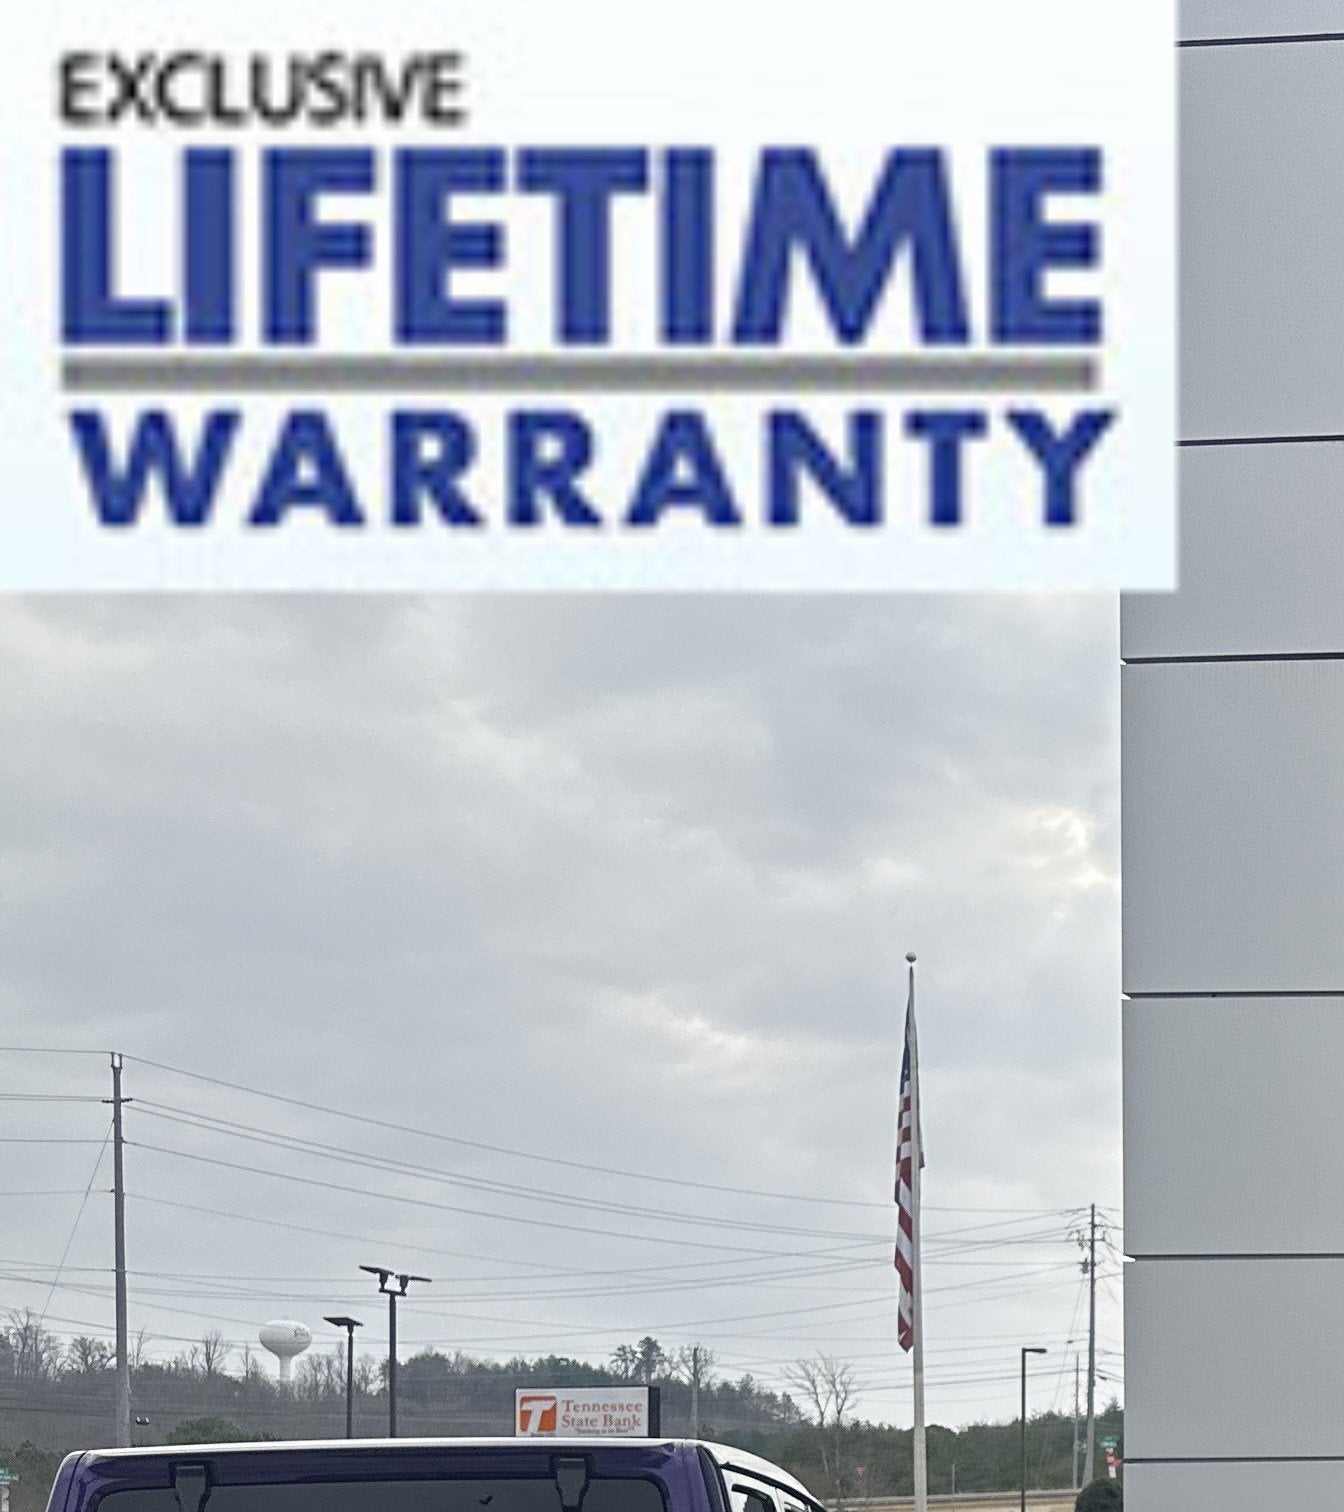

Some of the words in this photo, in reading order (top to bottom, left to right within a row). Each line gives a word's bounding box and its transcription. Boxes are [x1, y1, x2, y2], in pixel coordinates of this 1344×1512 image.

[561, 1399, 643, 1413] Tennessee
[561, 1414, 598, 1428] State
[603, 1413, 641, 1428] Bank
